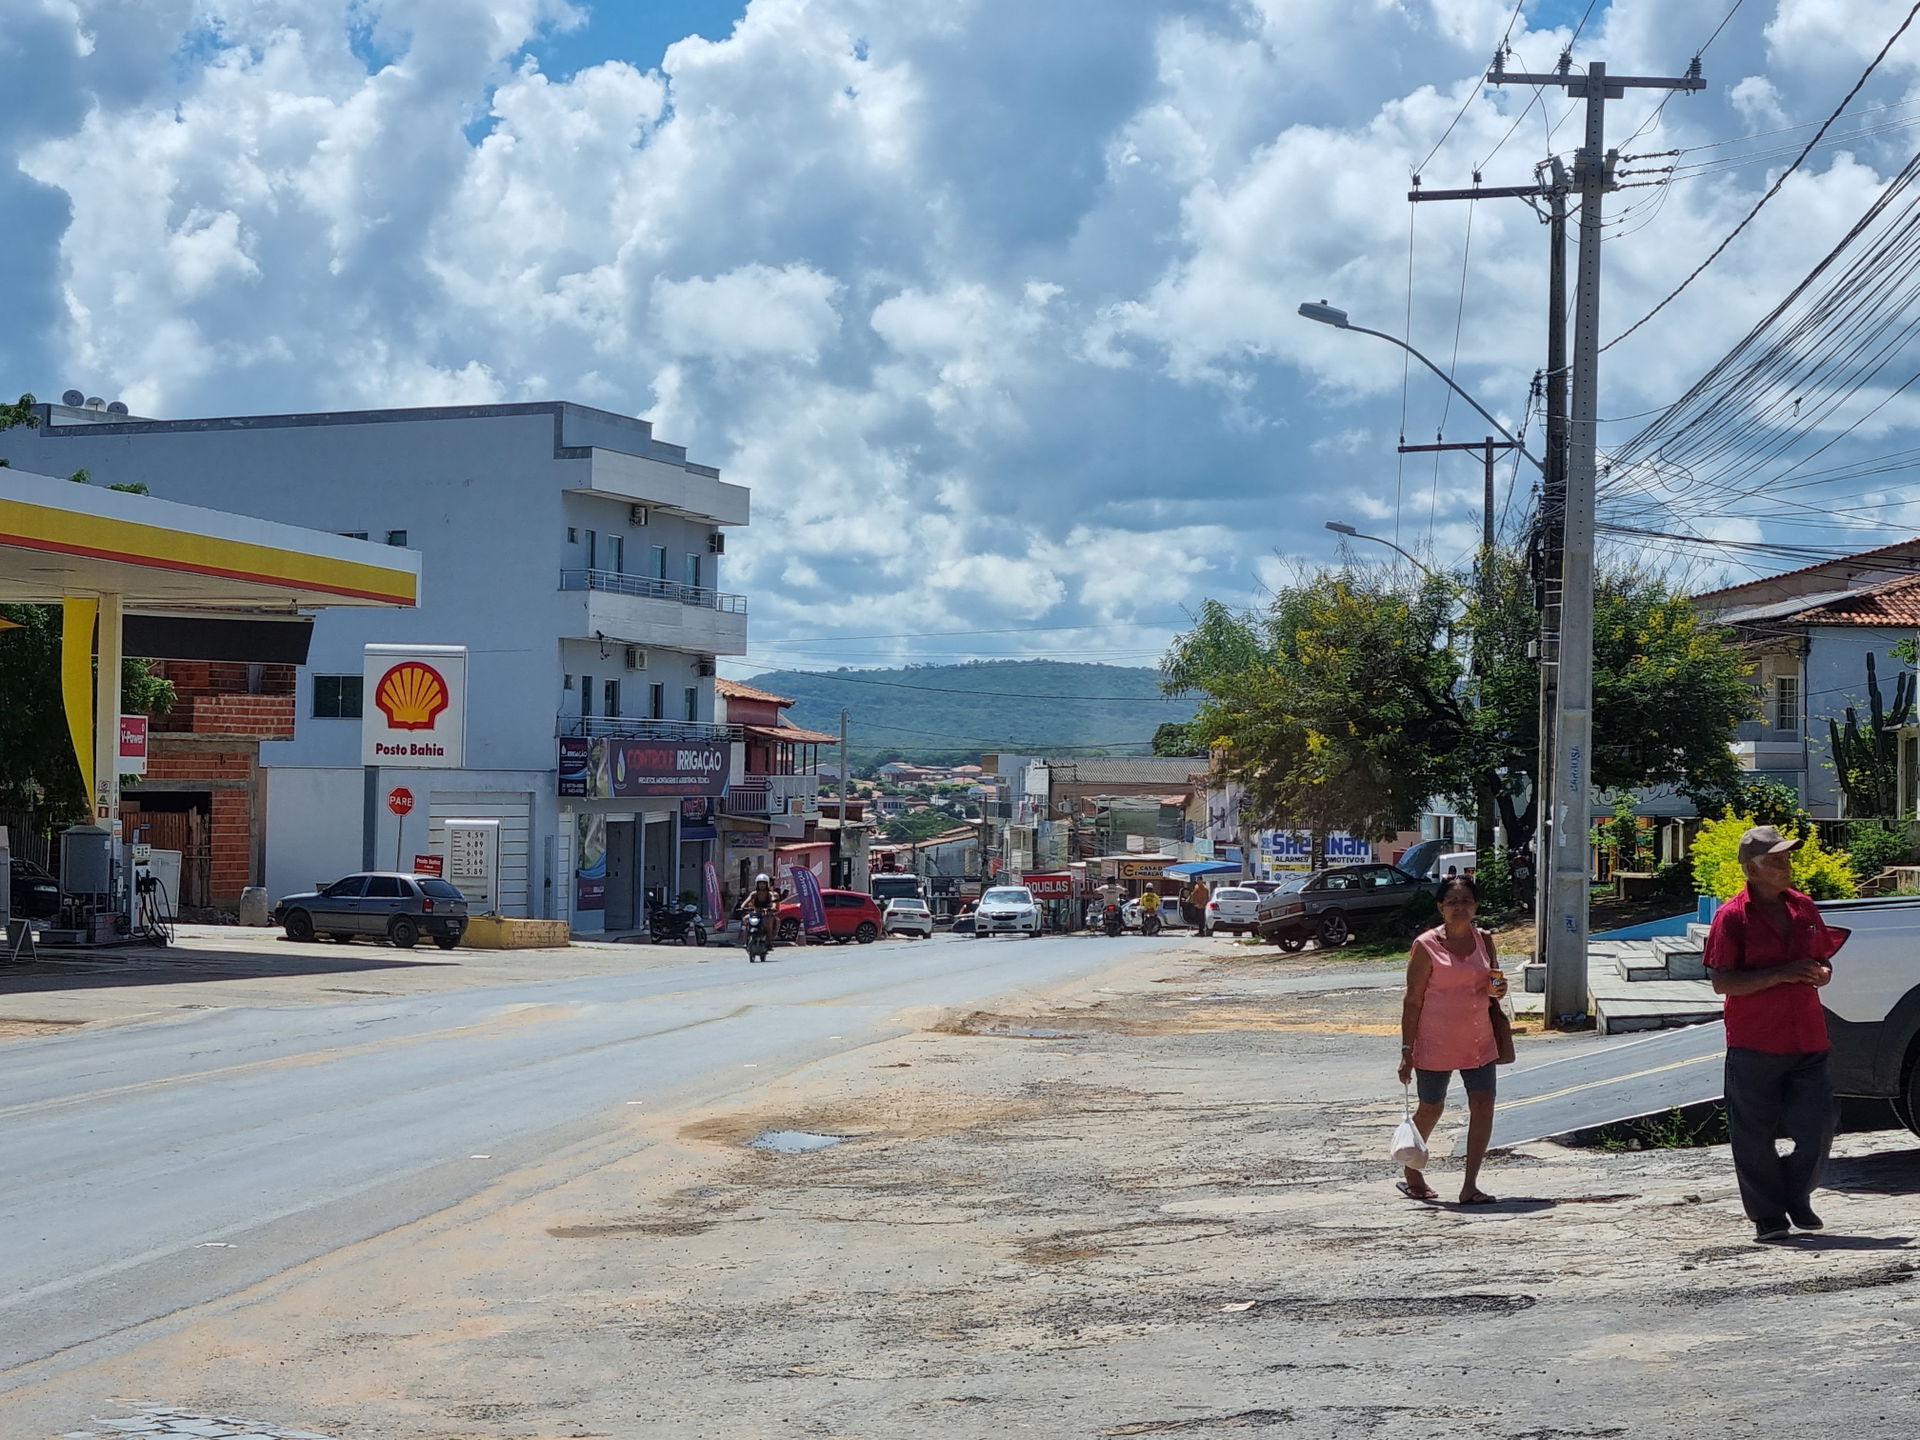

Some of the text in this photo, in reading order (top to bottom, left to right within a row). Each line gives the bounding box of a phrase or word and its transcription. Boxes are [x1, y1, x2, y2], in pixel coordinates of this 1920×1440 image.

[375, 743, 444, 757] Posto Bahia
[676, 748, 722, 775] IRRIGAÇÃO
[389, 796, 413, 807] PARE
[1321, 856, 1366, 864] OMOTIVOS
[1024, 880, 1069, 893] DOUGLAS
